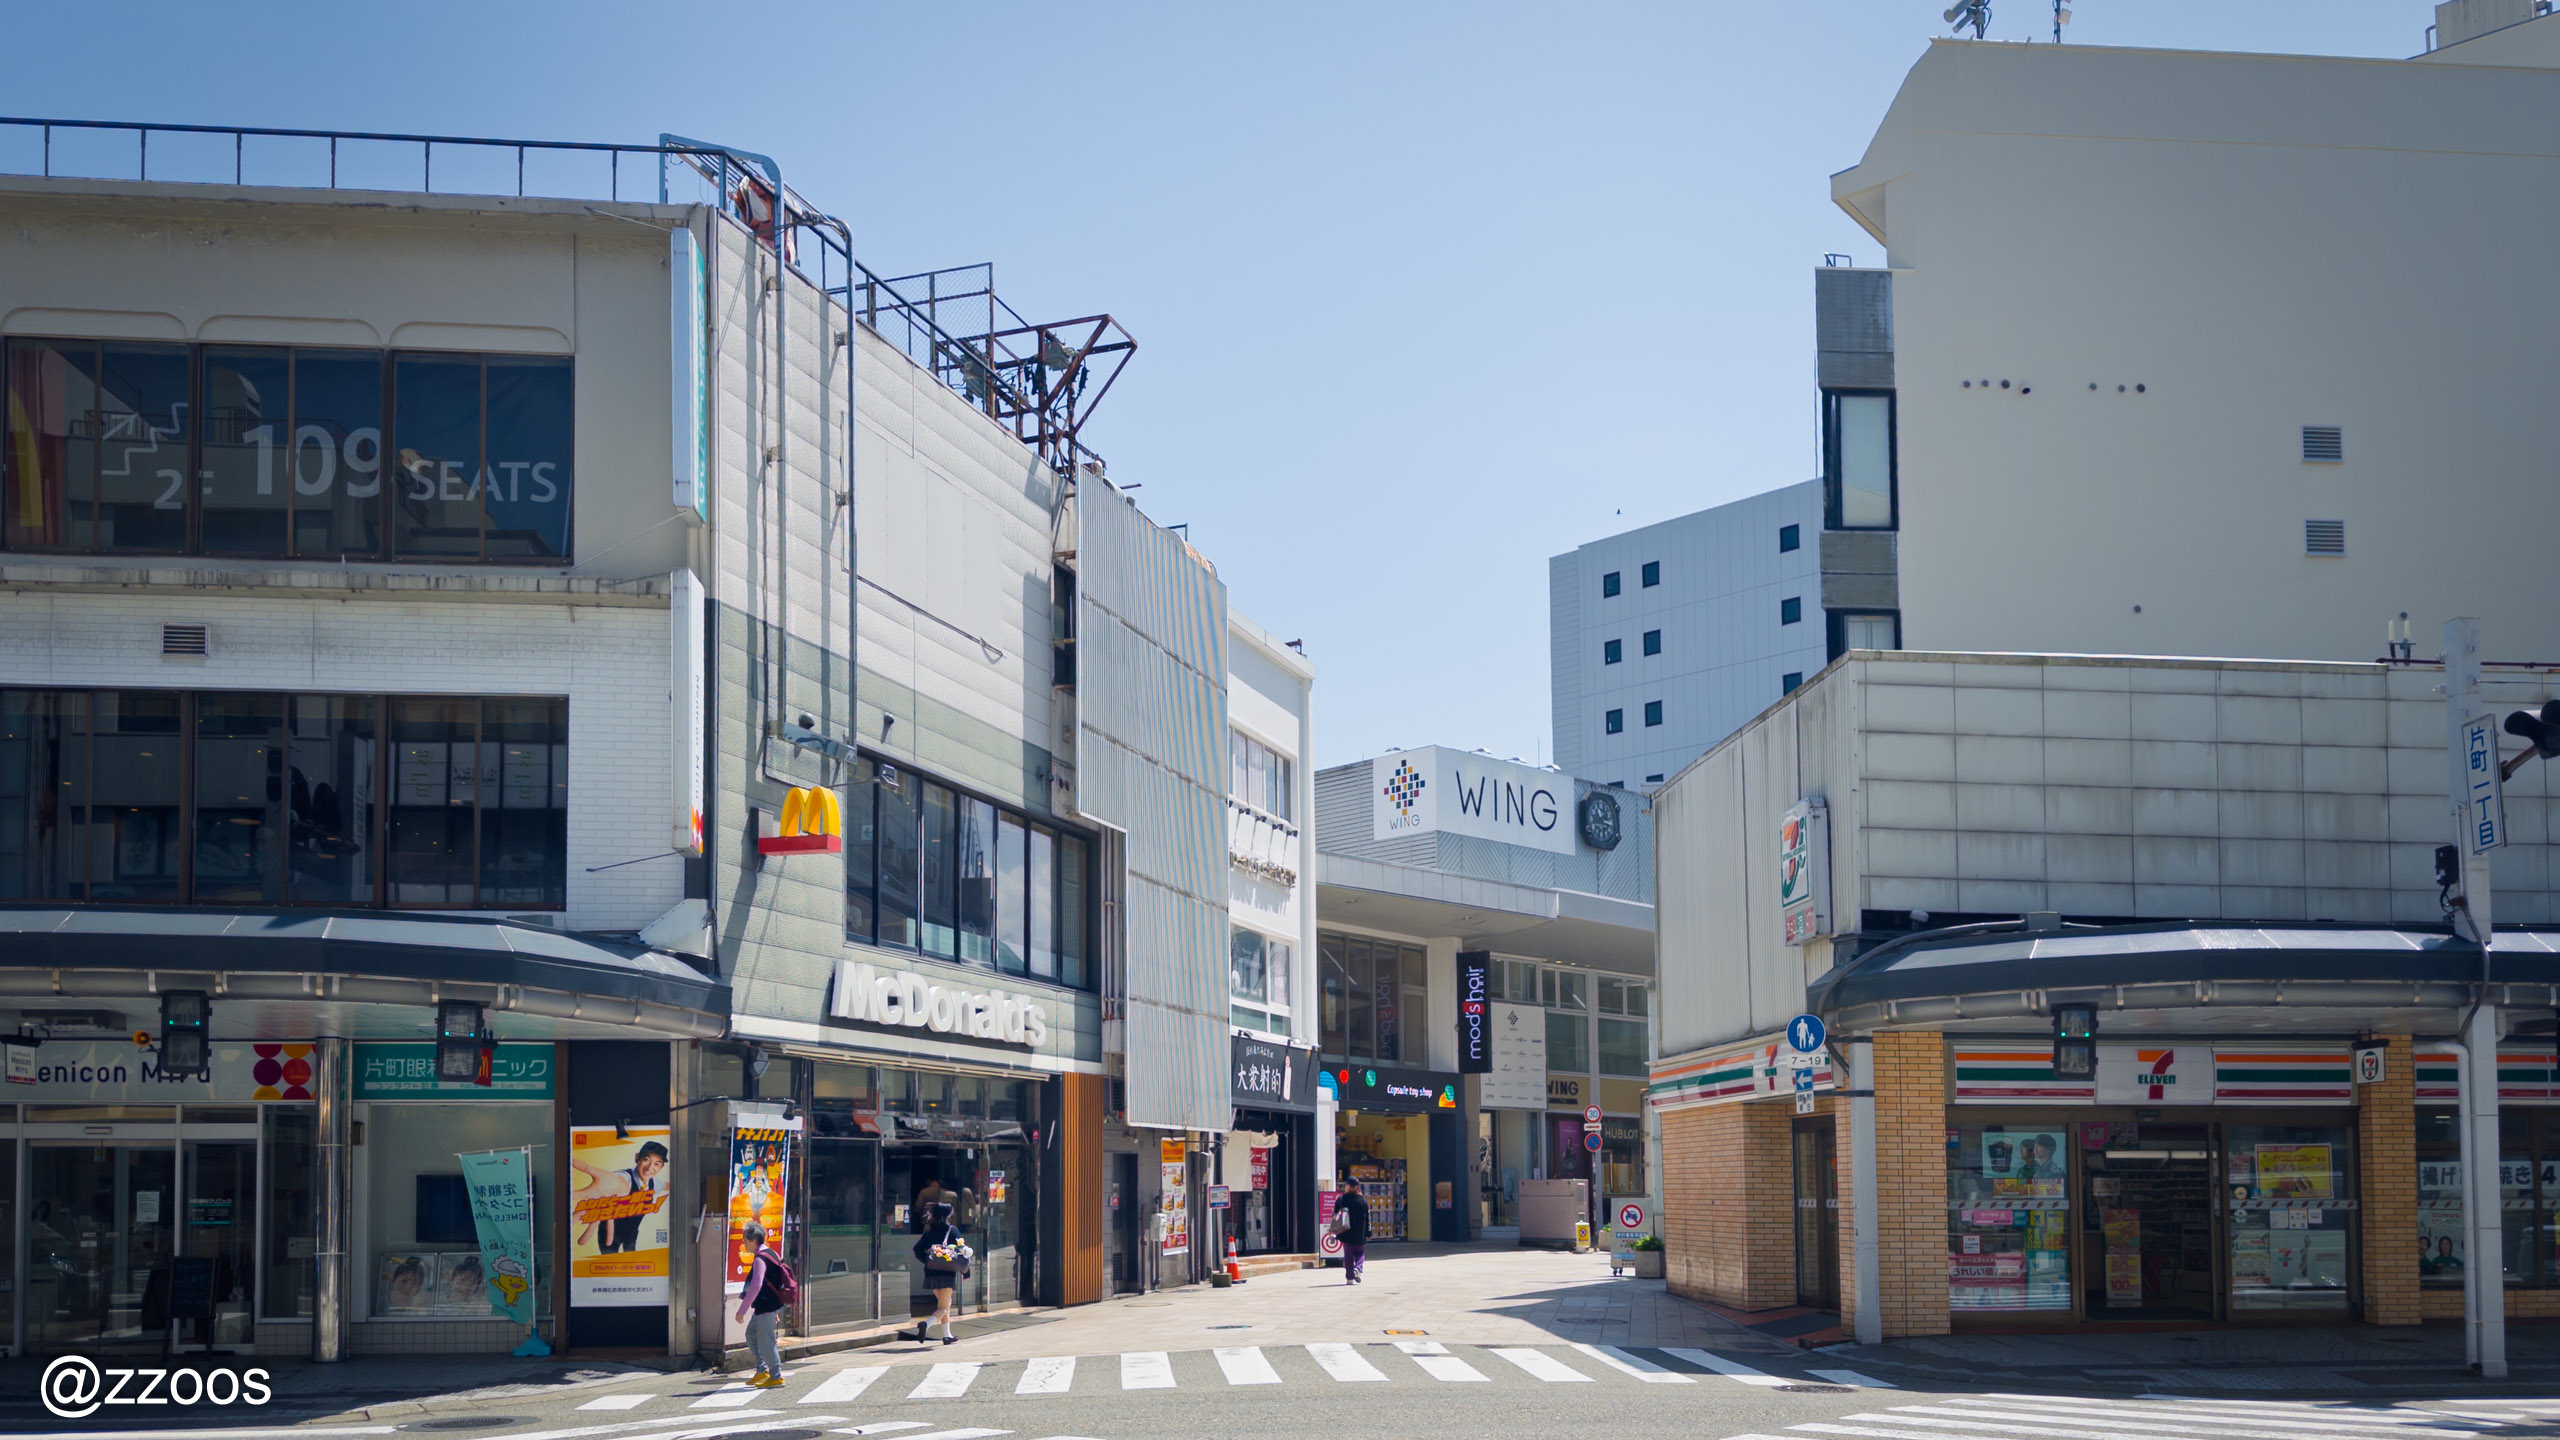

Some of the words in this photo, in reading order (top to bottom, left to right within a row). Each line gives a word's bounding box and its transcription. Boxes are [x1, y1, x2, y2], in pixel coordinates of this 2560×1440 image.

[241, 424, 382, 498] 109
[408, 460, 558, 503] SEATS
[2469, 726, 2495, 846] 片町一丁目
[1455, 770, 1558, 832] WING
[1389, 815, 1421, 831] WING
[830, 959, 1047, 1047] McDonald's
[365, 1058, 547, 1077] 片町眼ニック
[1791, 1056, 1822, 1066] 7-19
[38, 1060, 127, 1083] enicon
[141, 1060, 211, 1083] Mu
[1236, 1063, 1281, 1096] 大衆射的
[1387, 1084, 1408, 1096] Capsule
[1409, 1087, 1419, 1098] toy
[1420, 1087, 1433, 1099] shop
[1588, 1109, 1598, 1119] 30
[1604, 1127, 1639, 1140] HUBLOT
[2422, 1166, 2531, 1186] 揚げ焼き
